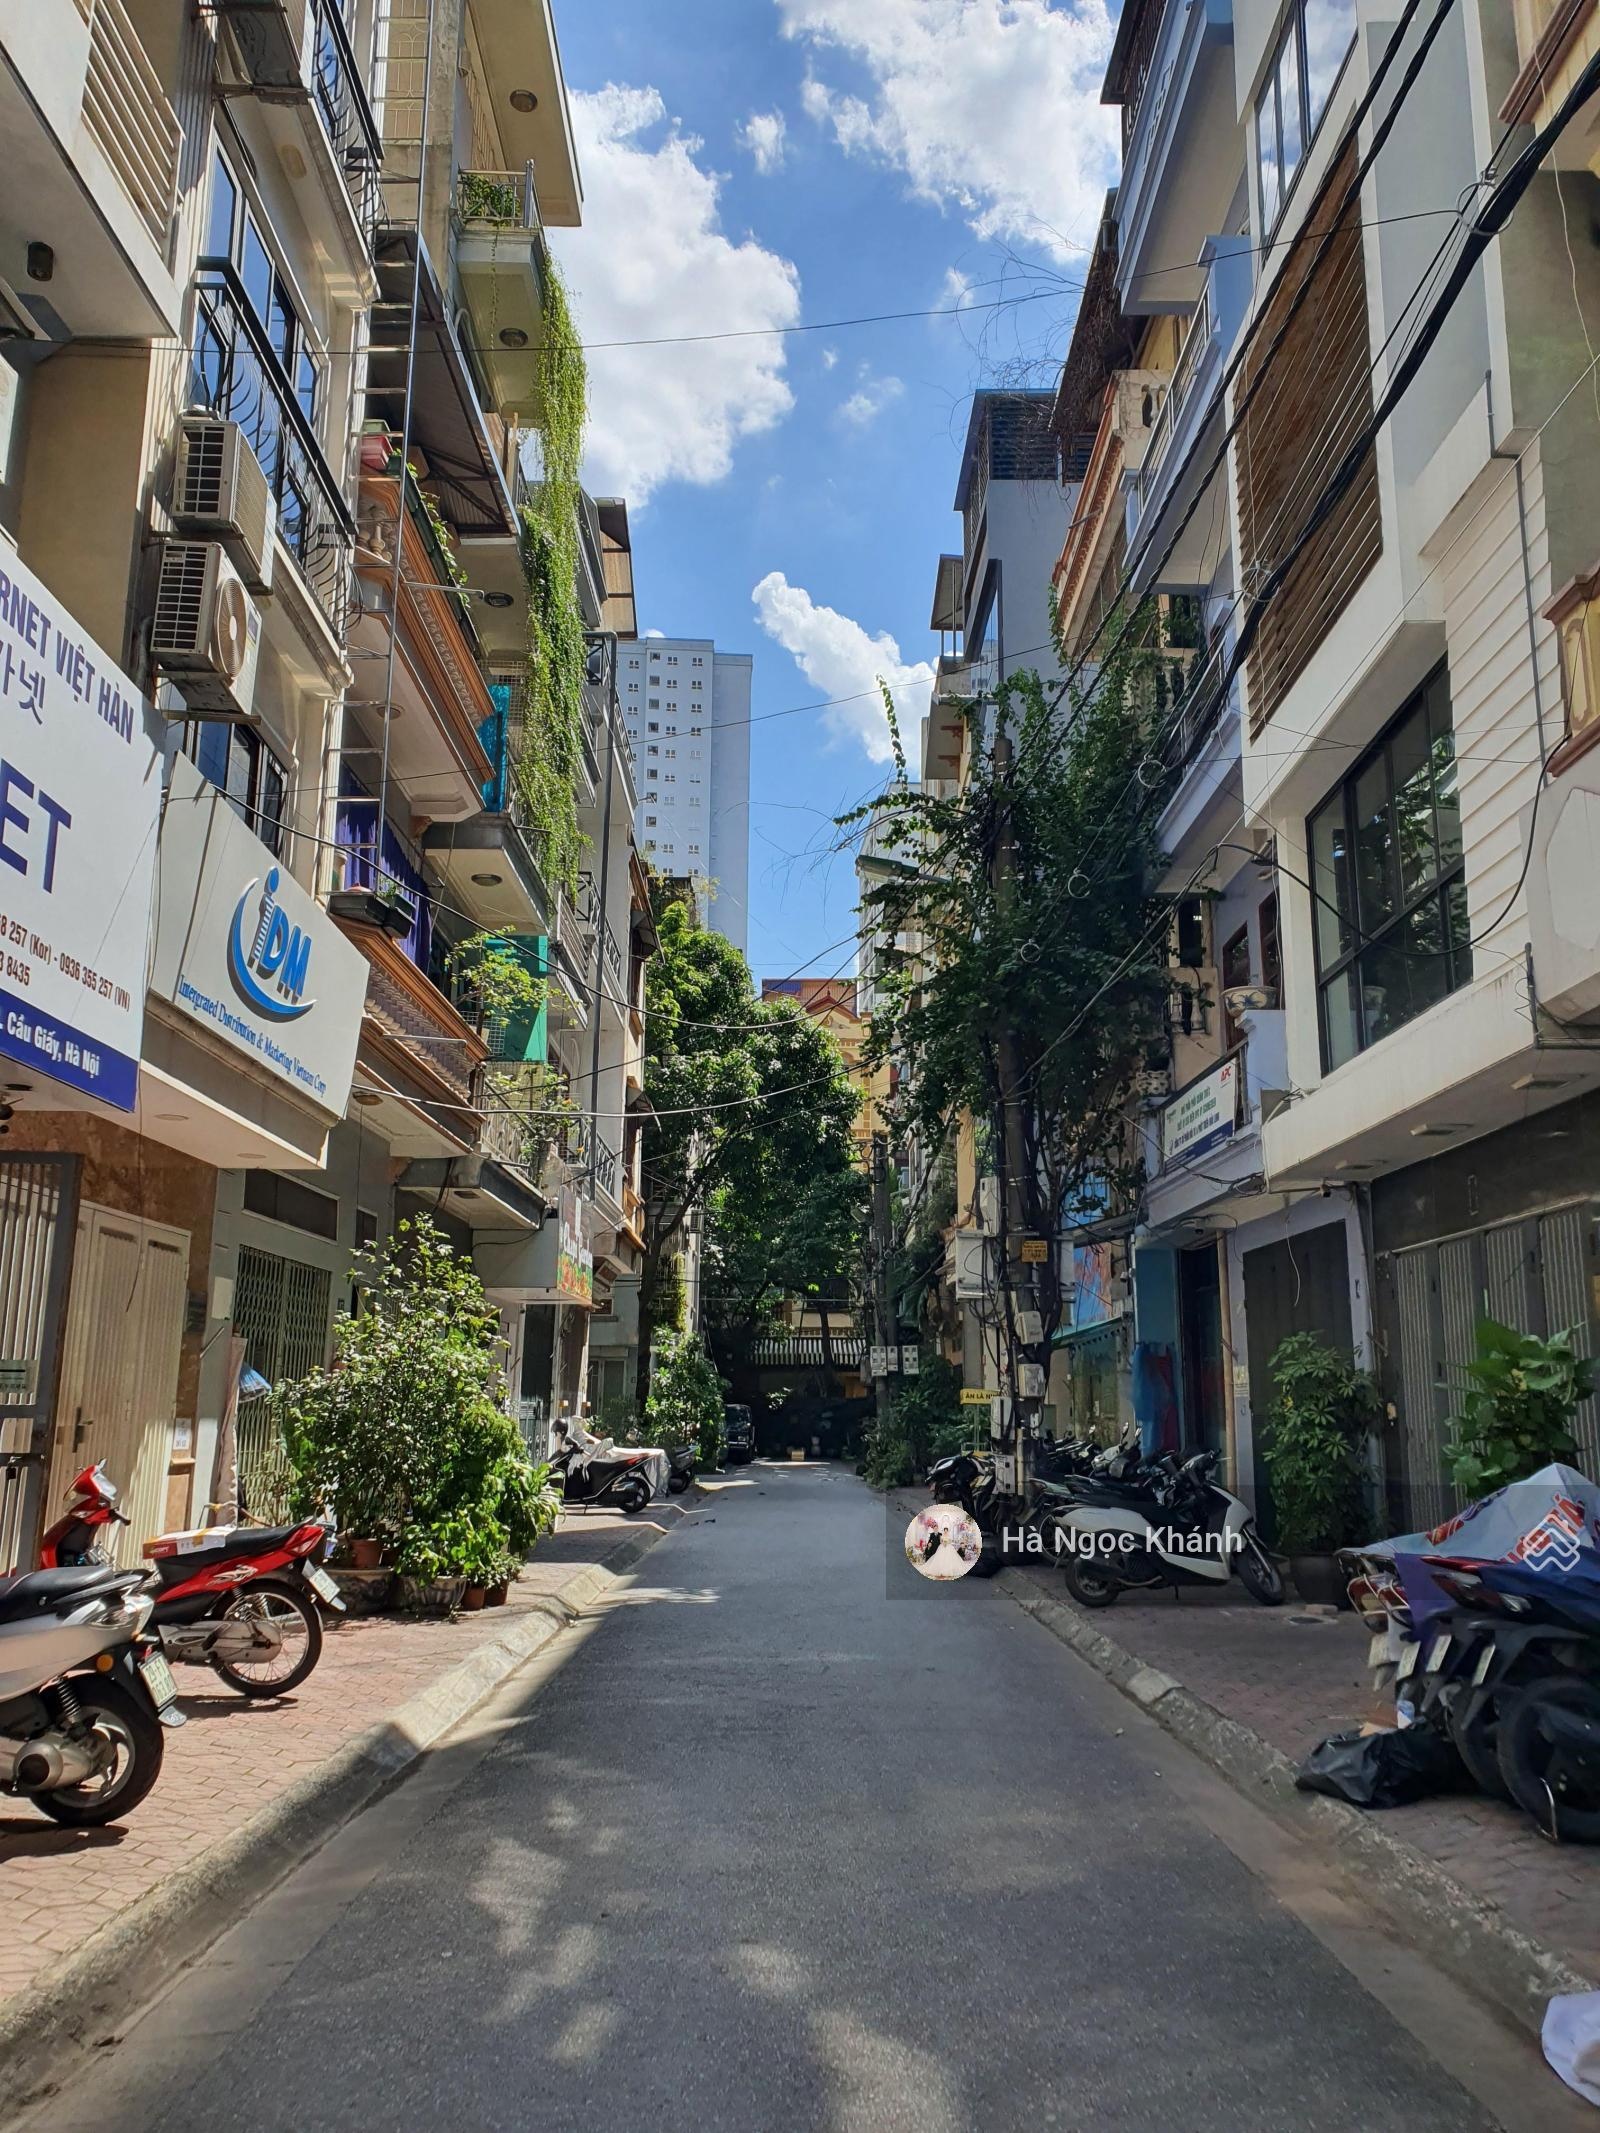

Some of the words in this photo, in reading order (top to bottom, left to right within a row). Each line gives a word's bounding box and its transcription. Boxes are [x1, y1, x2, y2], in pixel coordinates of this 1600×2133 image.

[55, 629, 96, 704] VIỆT
[97, 676, 135, 745] HÀN
[0, 757, 72, 894] ET
[7, 956, 30, 986] 8435
[9, 920, 28, 948] 257
[30, 933, 52, 965] (Kor)
[60, 952, 81, 981] 0936
[82, 966, 97, 991] 355
[98, 976, 113, 1000] 257
[114, 986, 131, 1013] (VN)
[7, 1011, 32, 1043] Cầu
[34, 1025, 62, 1062] Giấy,
[65, 1041, 80, 1067] Hà
[82, 1049, 100, 1079] Nội
